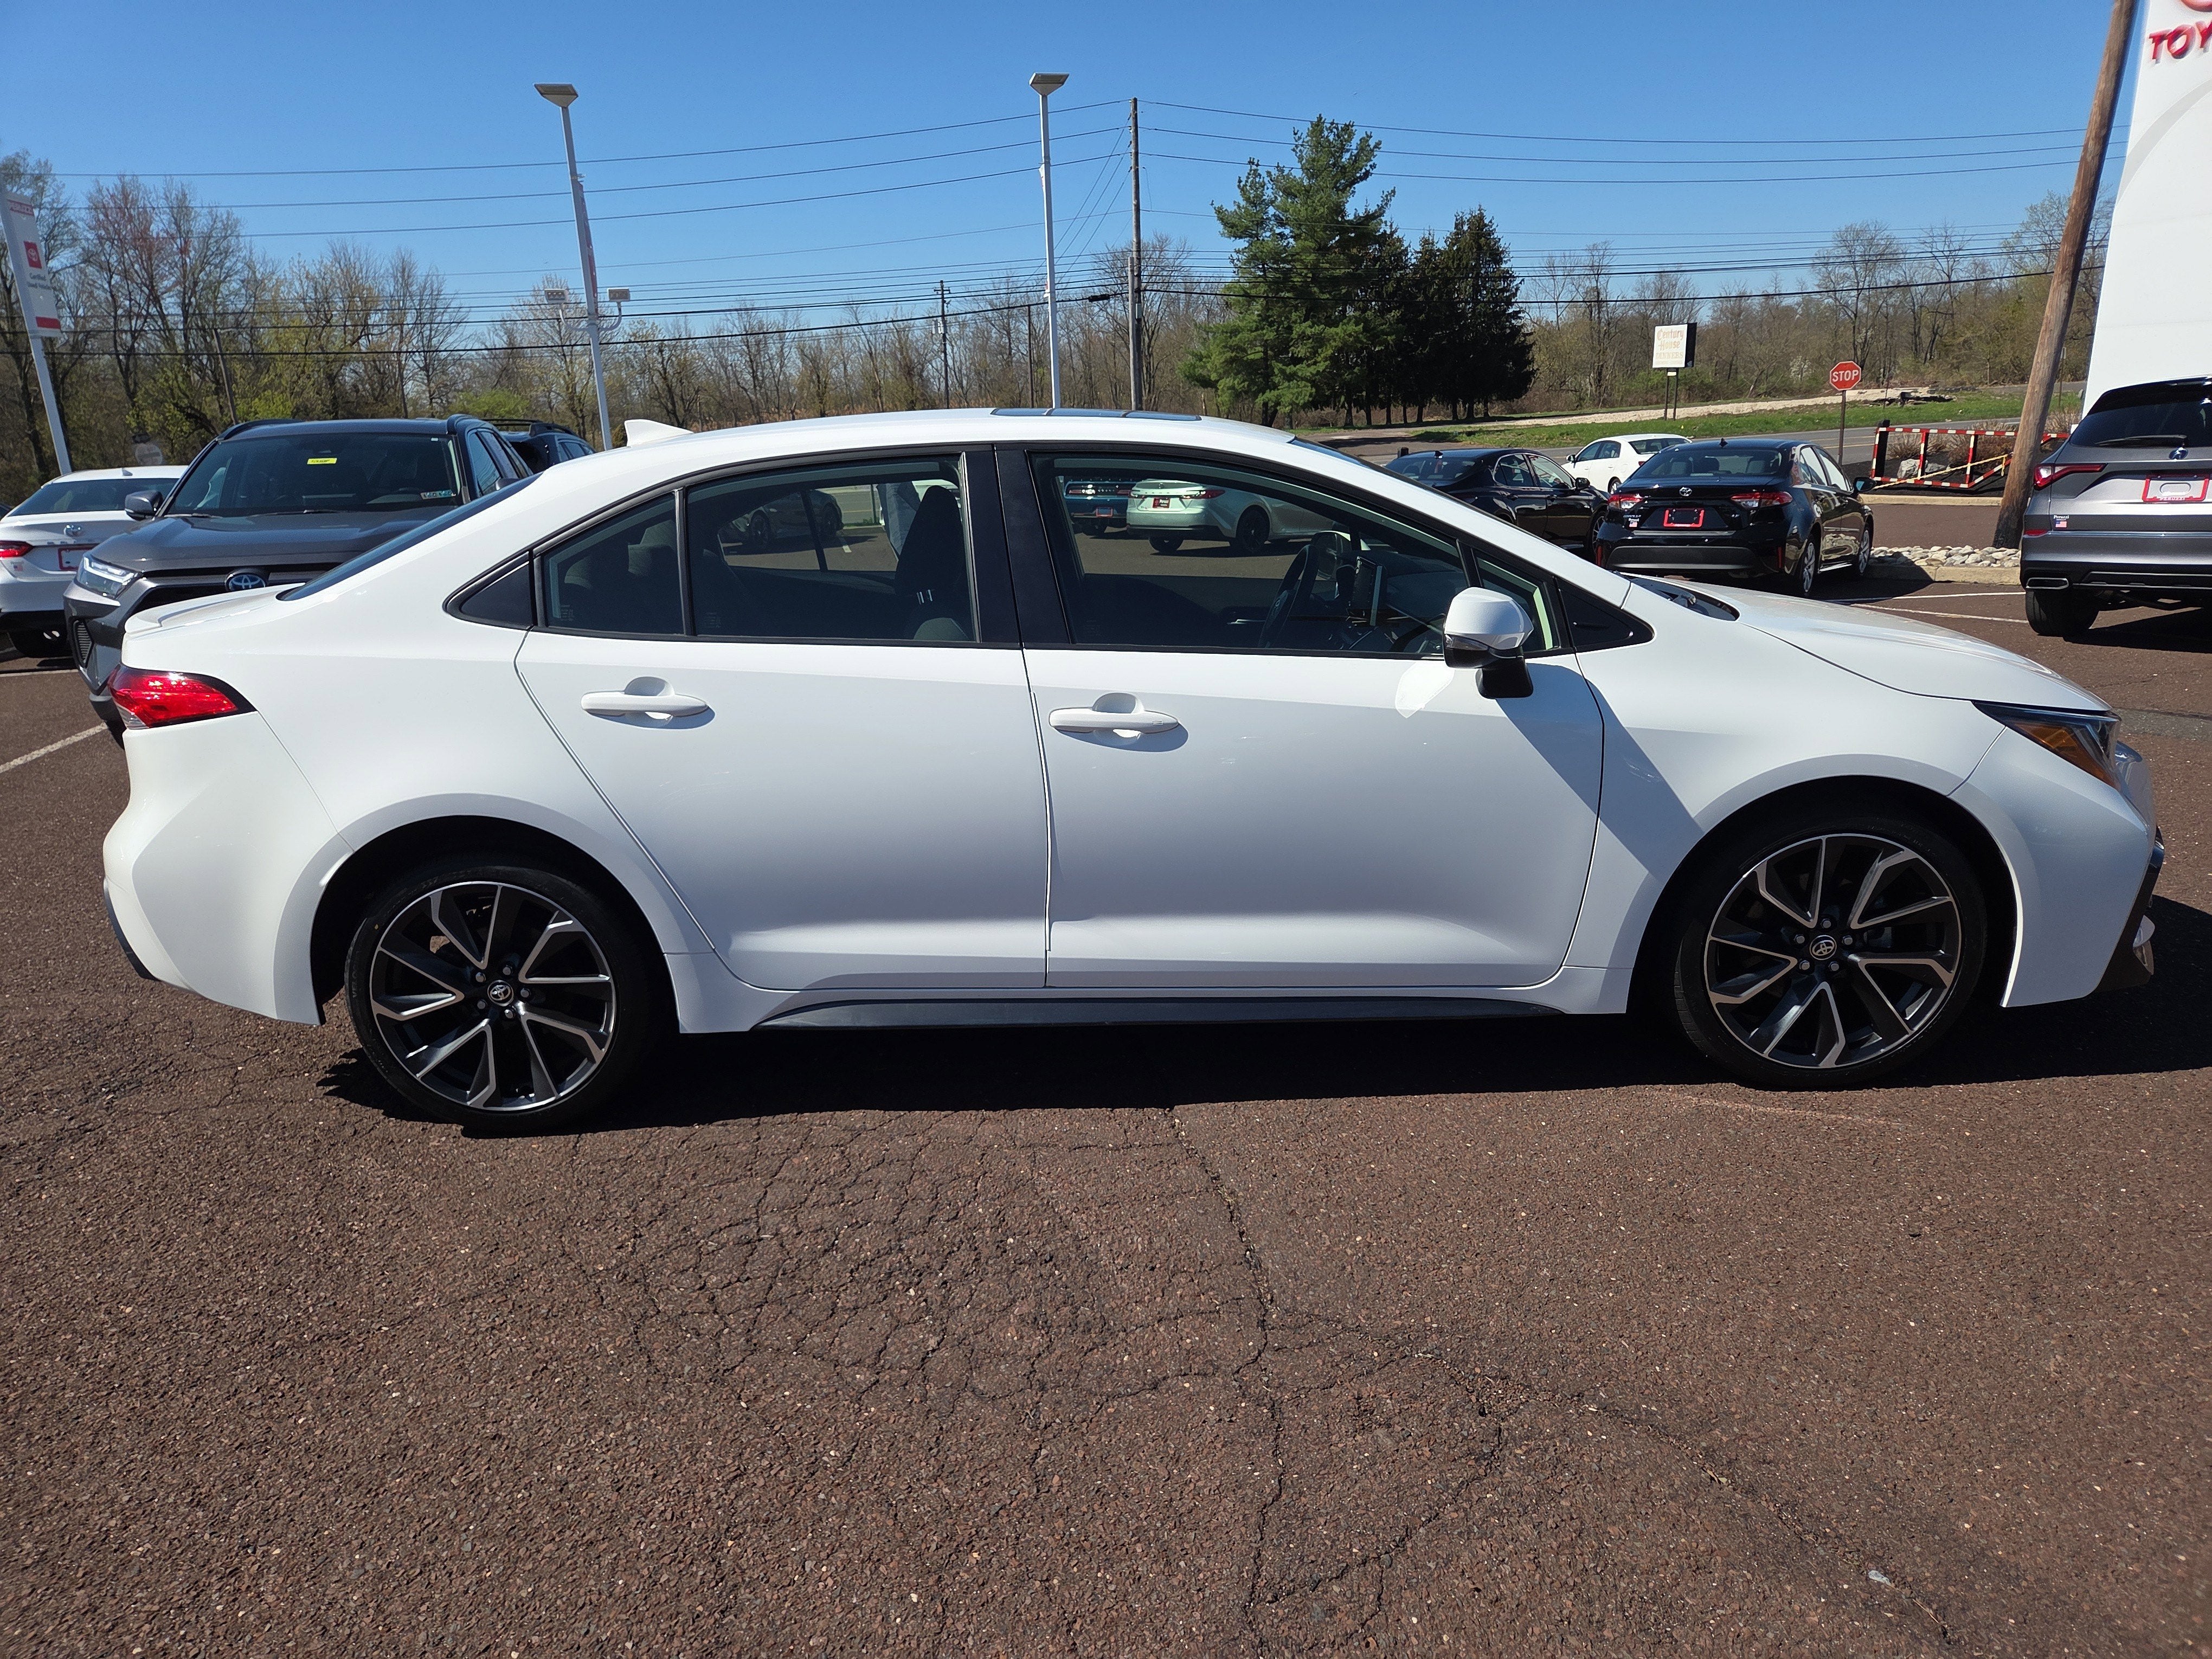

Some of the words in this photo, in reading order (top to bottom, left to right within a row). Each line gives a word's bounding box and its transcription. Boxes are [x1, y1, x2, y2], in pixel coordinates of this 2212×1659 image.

[1657, 329, 1684, 340] Century
[1658, 339, 1680, 351] House
[1832, 370, 1859, 382] STOP
